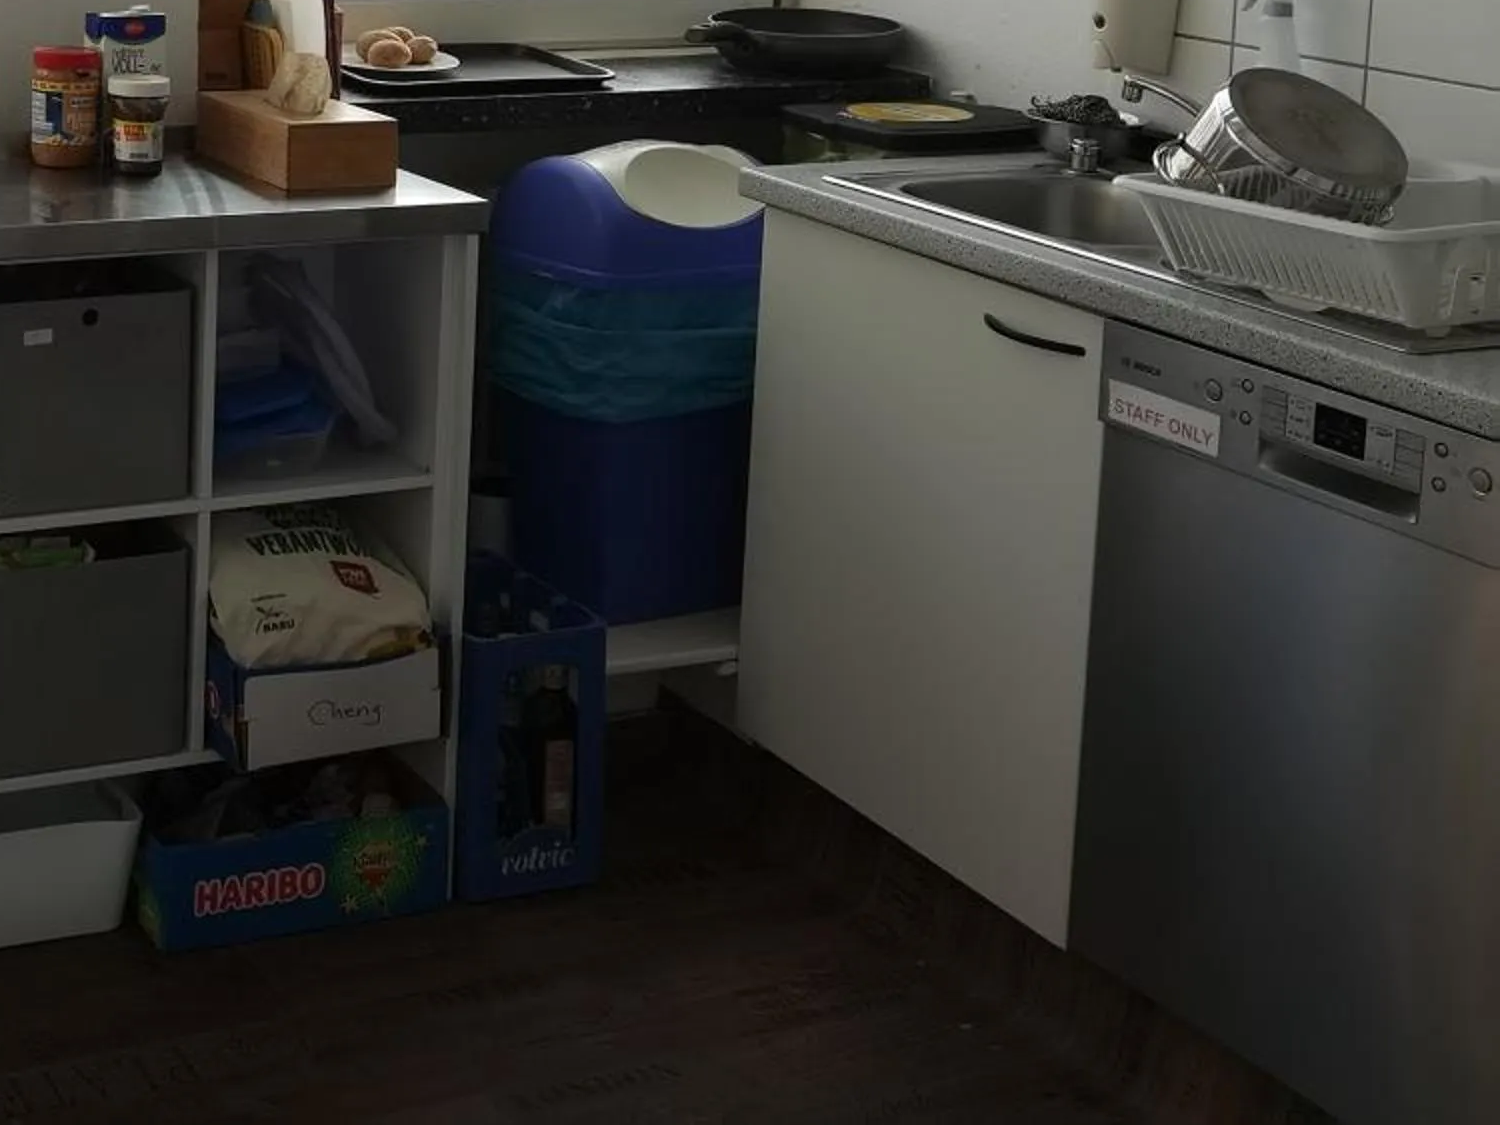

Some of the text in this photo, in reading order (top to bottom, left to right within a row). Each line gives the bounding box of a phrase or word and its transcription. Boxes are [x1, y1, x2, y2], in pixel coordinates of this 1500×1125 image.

[1115, 398, 1214, 446] STAFF ONLY
[307, 699, 384, 727] Cheng
[195, 863, 326, 918] HARIBO
